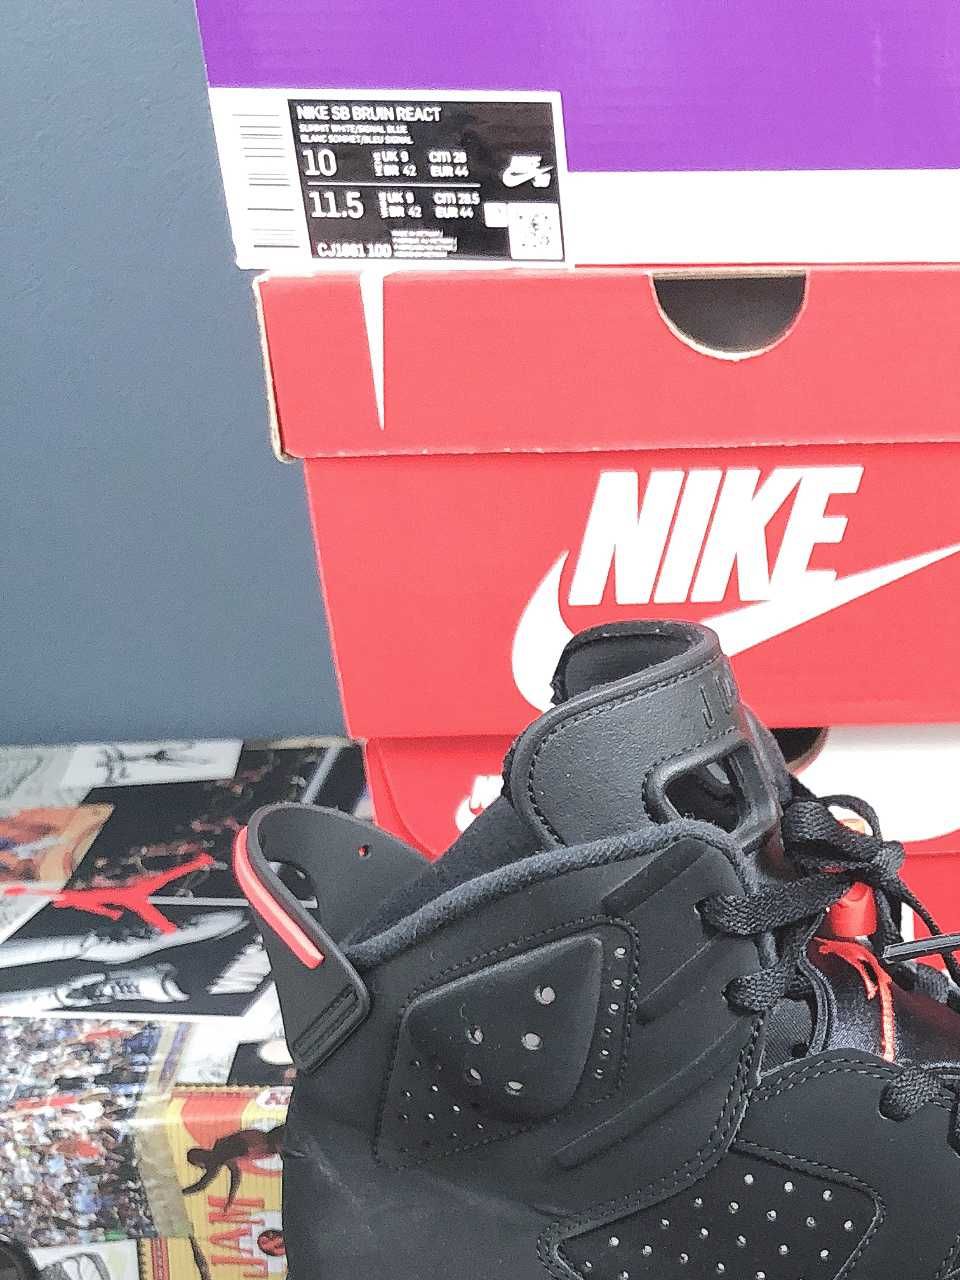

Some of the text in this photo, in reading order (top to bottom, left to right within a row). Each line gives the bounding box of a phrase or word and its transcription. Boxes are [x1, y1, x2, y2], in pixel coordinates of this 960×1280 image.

[296, 105, 442, 123] NIKE SB BRUIN REACT
[302, 148, 337, 177] 10
[308, 190, 364, 219] 11.5
[567, 464, 866, 607] NIKE
